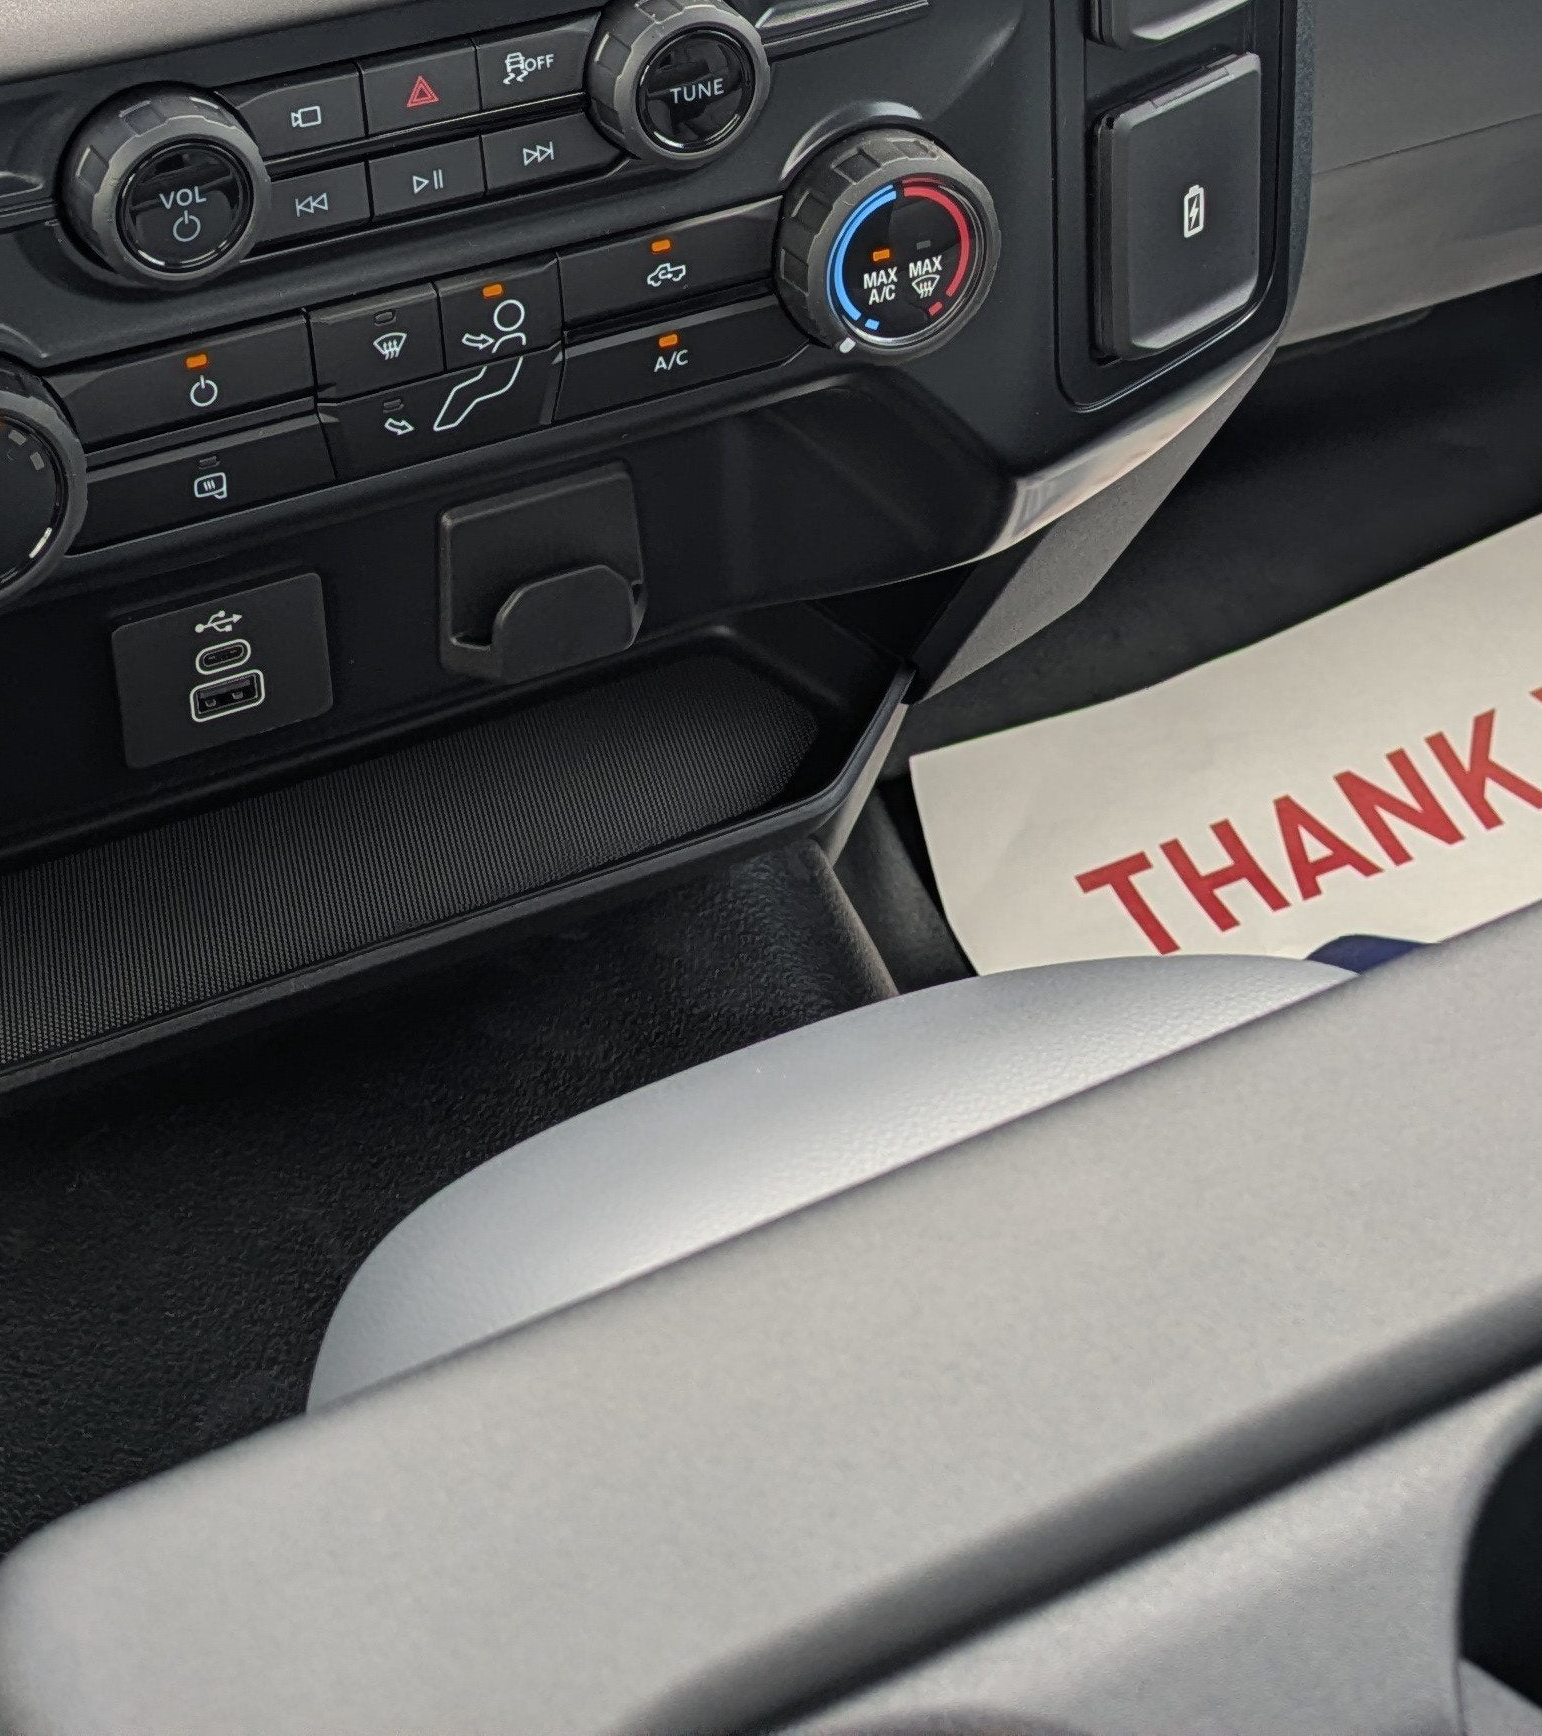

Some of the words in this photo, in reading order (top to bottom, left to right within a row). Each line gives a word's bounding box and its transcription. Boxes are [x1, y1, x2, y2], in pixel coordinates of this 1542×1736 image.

[525, 53, 555, 72] OFF
[670, 77, 725, 104] TUNE
[159, 186, 207, 210] VOL
[863, 266, 898, 290] MAX
[907, 254, 943, 279] MAX
[868, 284, 896, 306] A/C
[653, 347, 689, 372] A/C
